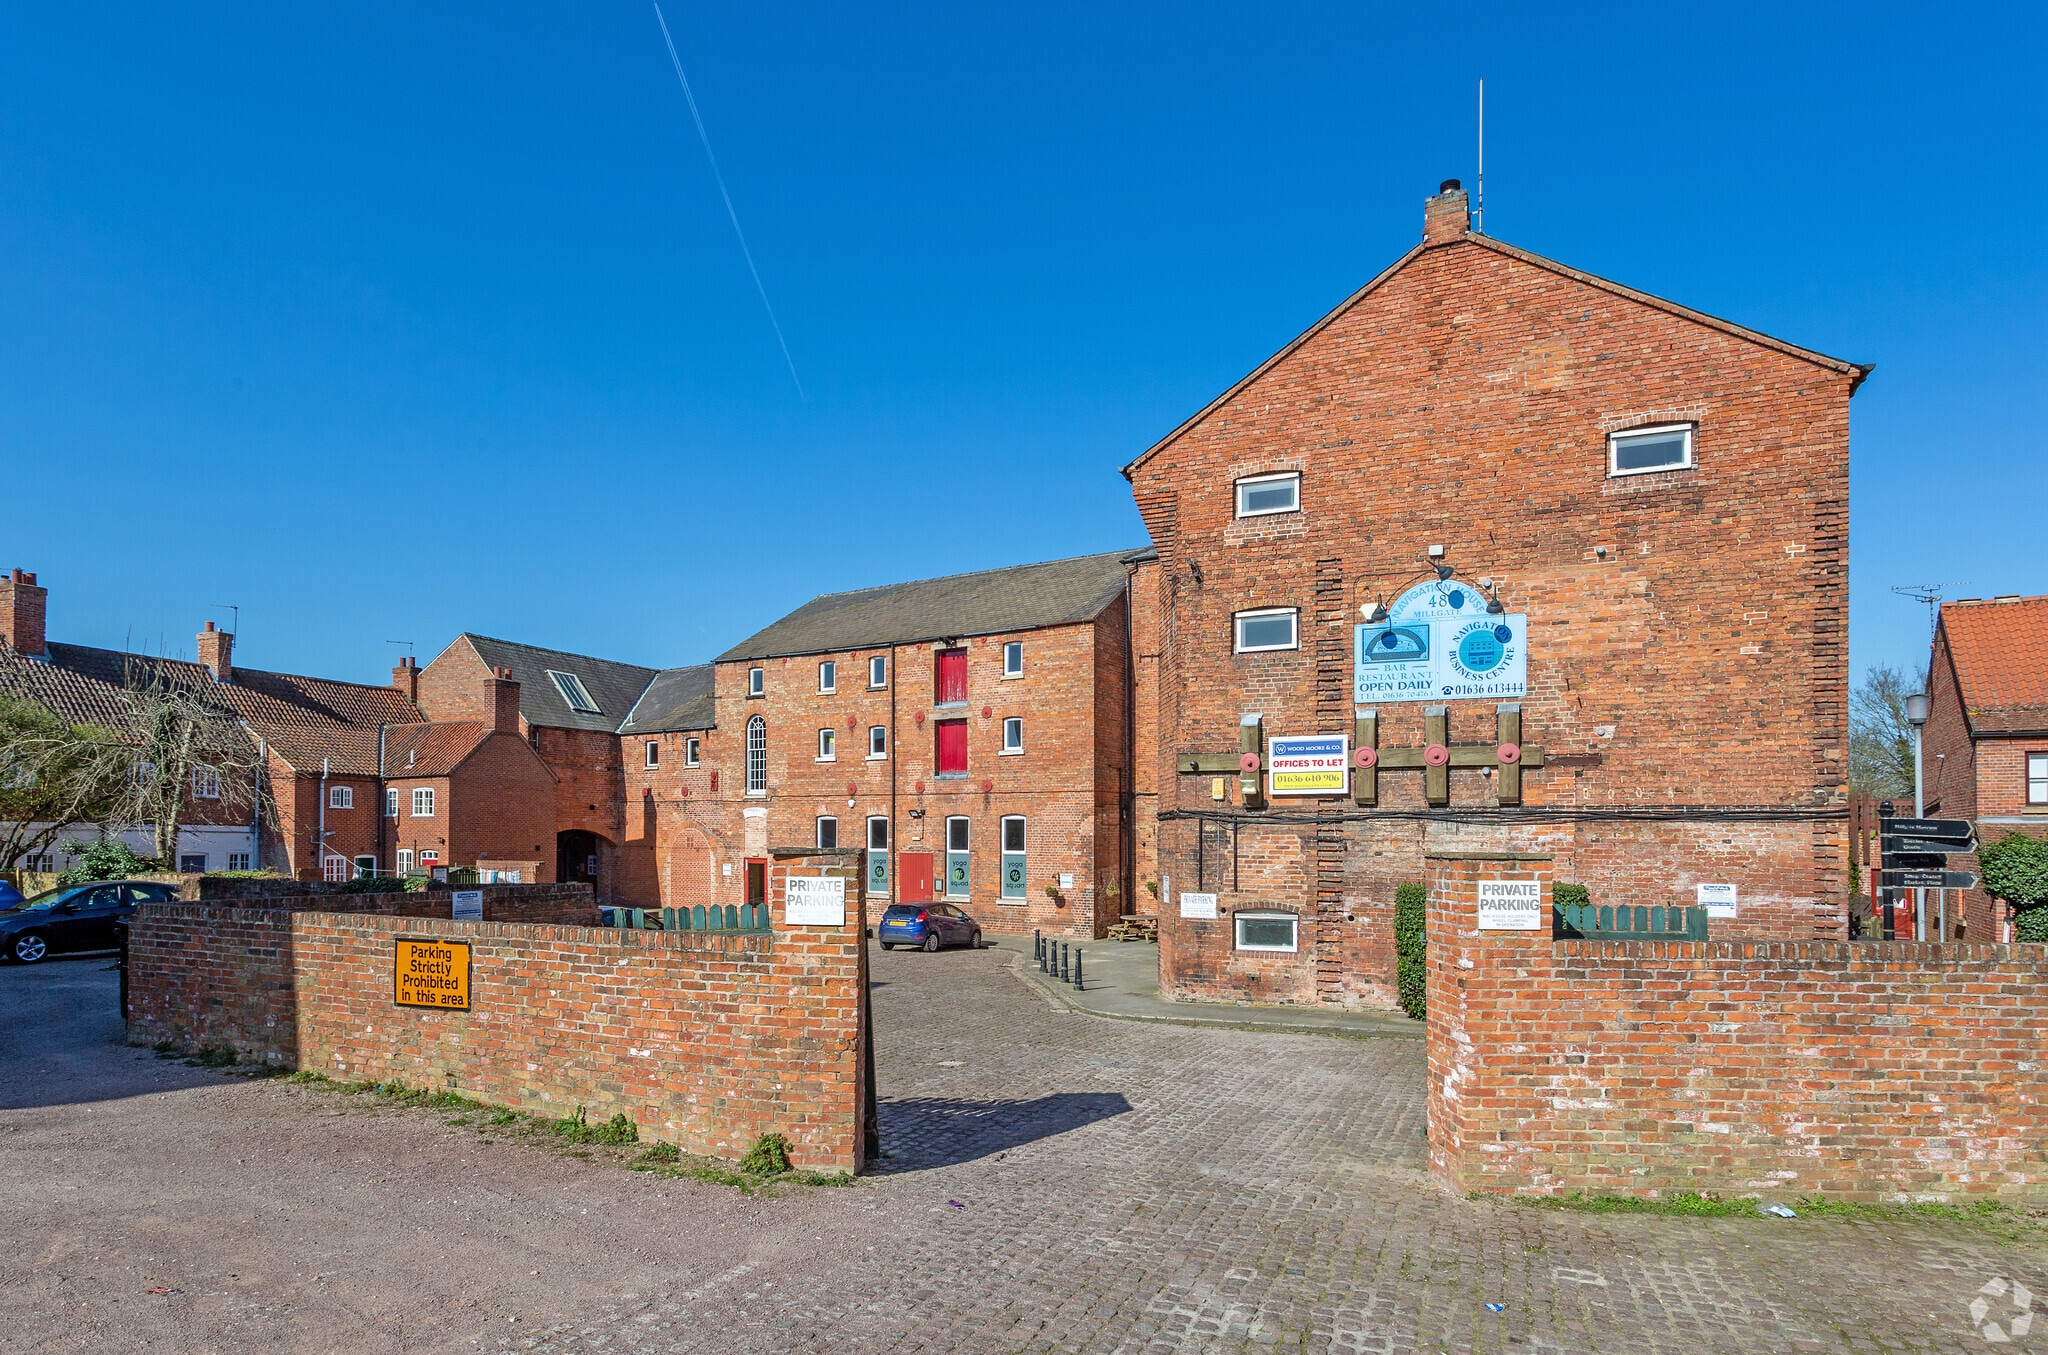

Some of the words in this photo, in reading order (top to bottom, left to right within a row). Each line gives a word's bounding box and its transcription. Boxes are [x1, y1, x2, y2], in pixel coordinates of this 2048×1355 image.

[1391, 583, 1452, 618] NAVIGATION
[1456, 585, 1485, 613] HOUSE
[1428, 594, 1448, 608] 48
[1413, 609, 1463, 618] MILLGATE
[1452, 621, 1511, 643] NAVIGATION
[1384, 664, 1407, 672] BAR
[1449, 650, 1484, 681] BUSINESS
[1486, 647, 1515, 680] CENTRE
[1359, 671, 1433, 681] RESTAURANT
[1359, 682, 1393, 692] OPEN
[1398, 680, 1433, 690] DAILY
[1455, 684, 1484, 695] 01636
[1487, 682, 1524, 693] 613444
[1273, 759, 1310, 768] OFFICES
[1312, 759, 1324, 767] TO
[1327, 758, 1344, 767] LET
[1277, 775, 1303, 783] 01636
[1305, 774, 1321, 782] 610
[1323, 774, 1340, 782] 906
[789, 880, 842, 892] PRIVATE
[1482, 884, 1538, 896] PRIVATE
[787, 894, 844, 907] PARKING
[1480, 898, 1540, 911] PARKING
[411, 945, 452, 962] Parking
[410, 959, 452, 977] Strictly
[403, 974, 459, 990] Prohibited
[402, 988, 411, 1001] in
[416, 989, 436, 1003] this
[441, 994, 464, 1005] area
